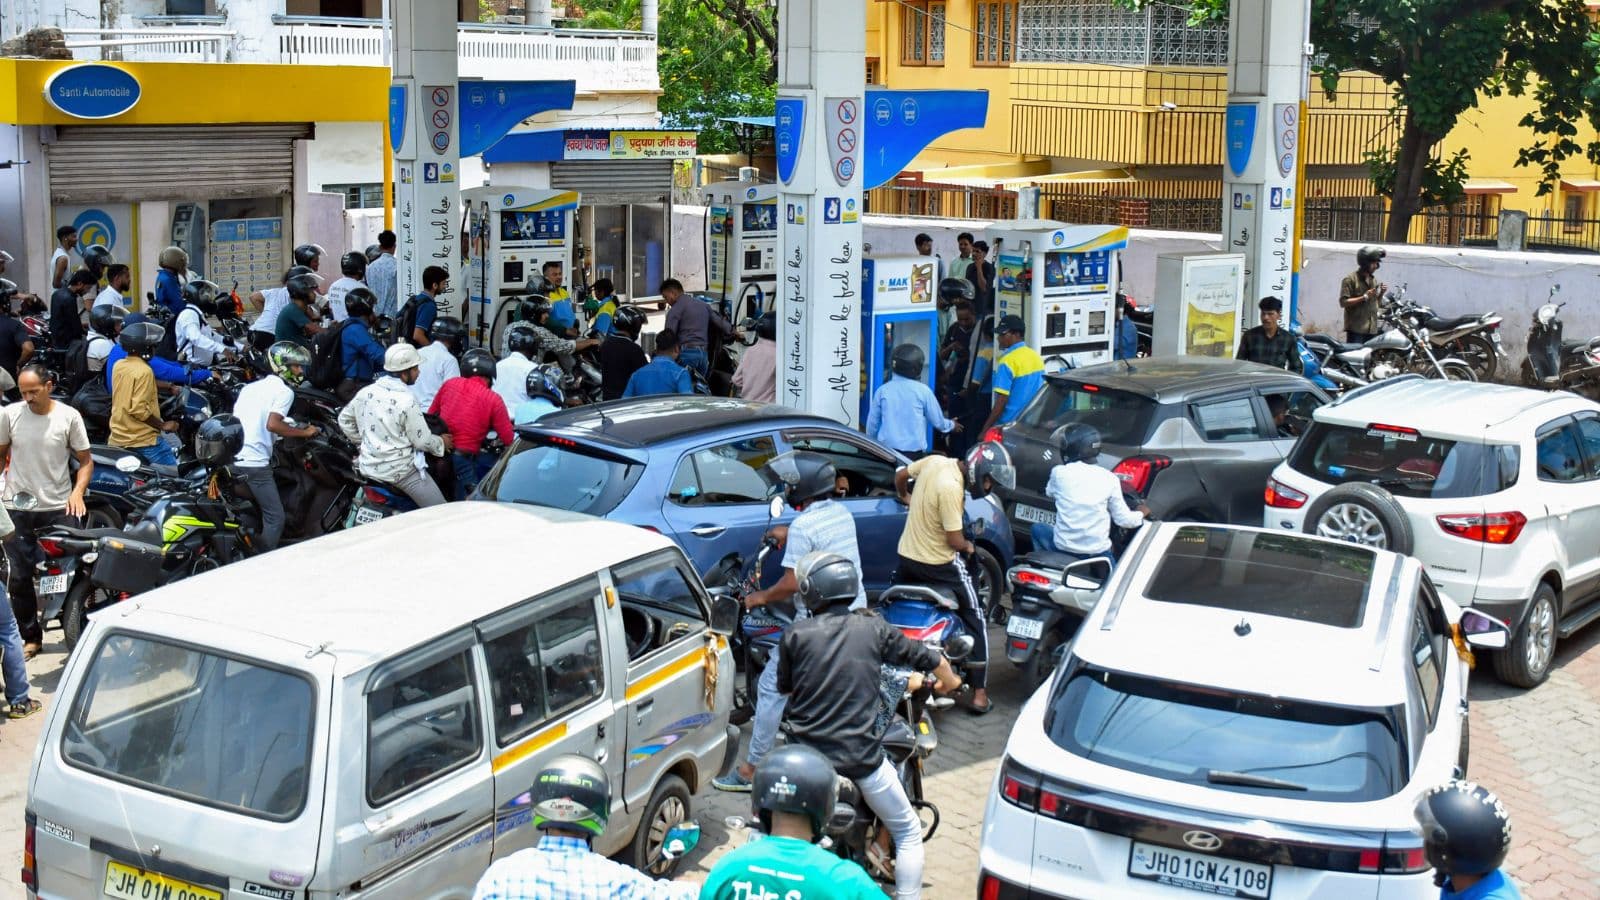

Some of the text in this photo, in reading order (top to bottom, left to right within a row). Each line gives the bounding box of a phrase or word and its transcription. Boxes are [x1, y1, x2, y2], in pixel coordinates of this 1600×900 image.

[60, 86, 130, 97] Santi Automobile
[430, 219, 455, 241] feel
[431, 243, 452, 259] ko
[888, 278, 908, 287] MAK
[787, 245, 805, 397] Ab future ko feel kar
[828, 240, 855, 393] Ab future ko feel kar
[44, 820, 74, 837] MARUTI
[45, 826, 75, 842] SUZUKI
[1144, 849, 1268, 891] JH01GN4108
[115, 875, 138, 897] JH
[284, 889, 293, 900] E
